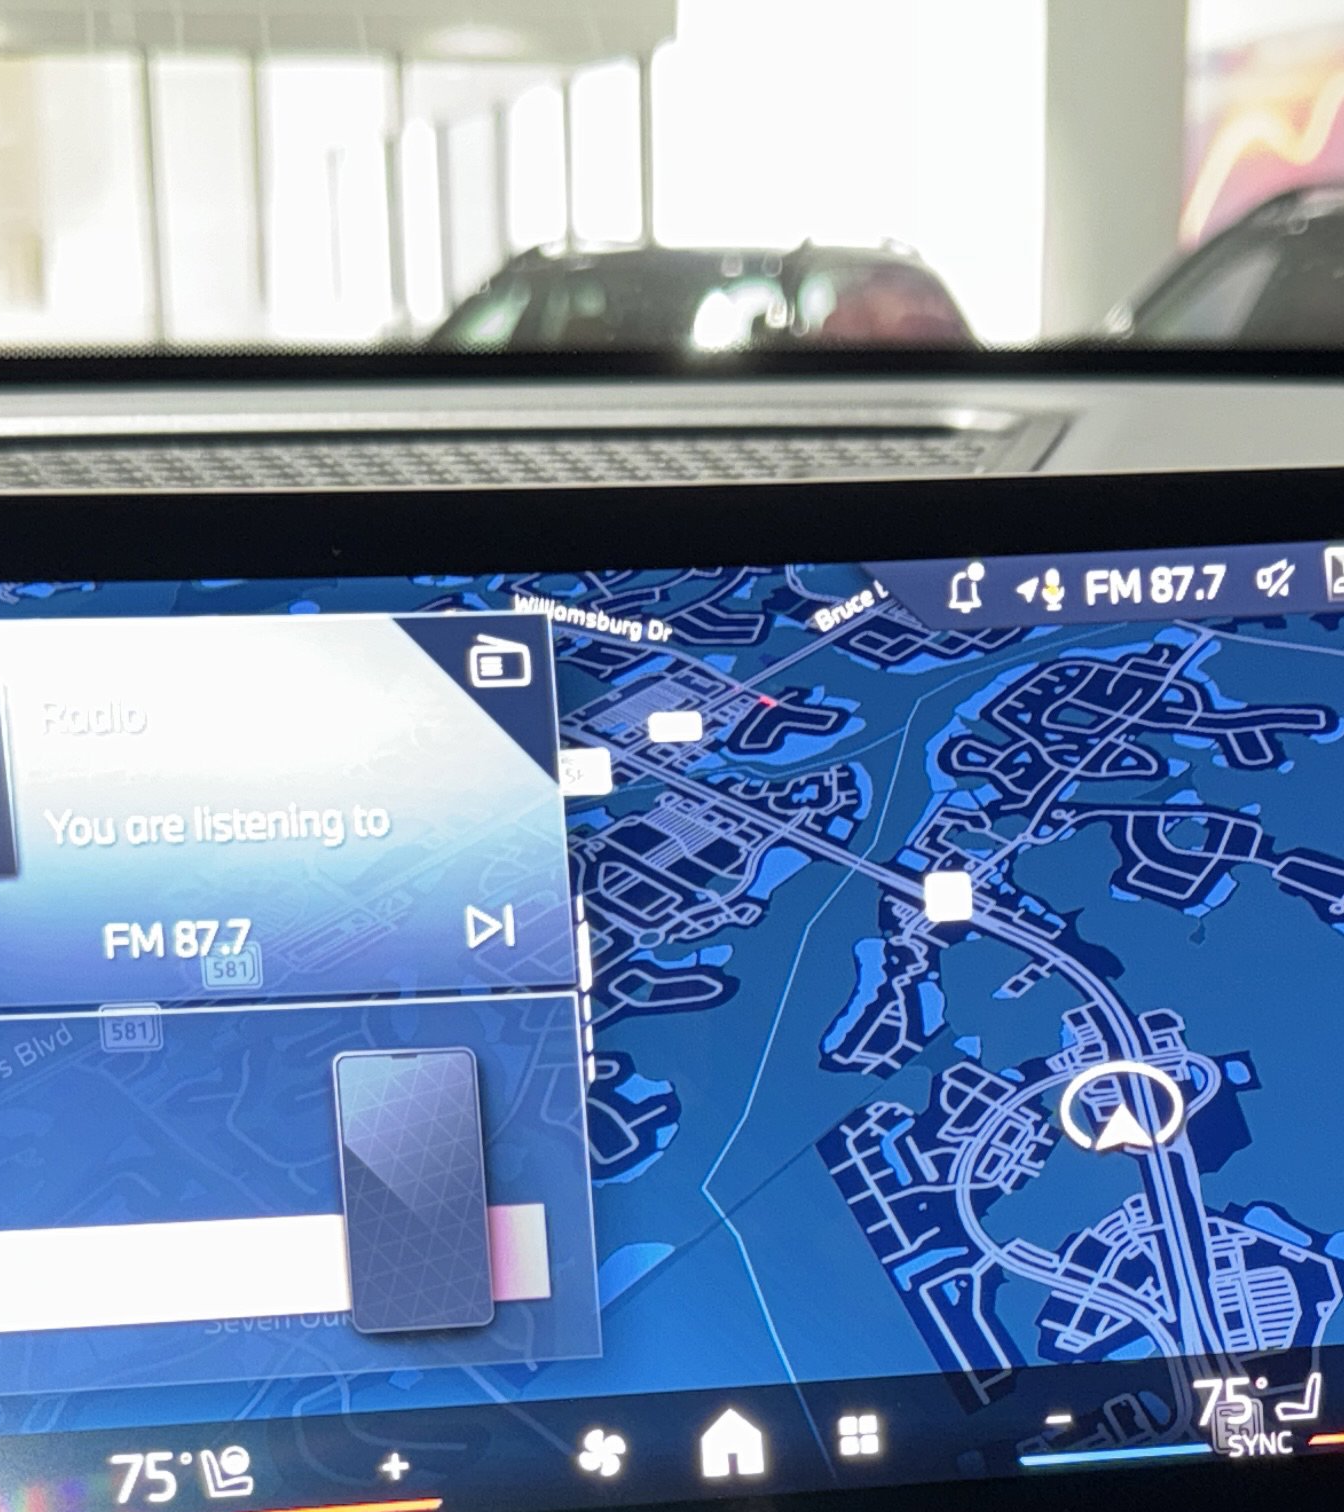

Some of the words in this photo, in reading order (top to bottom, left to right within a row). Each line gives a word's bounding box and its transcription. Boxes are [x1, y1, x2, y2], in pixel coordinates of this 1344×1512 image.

[1086, 567, 1142, 605] FM
[1150, 564, 1227, 603] 87.7
[513, 593, 643, 642] Williamsburg
[646, 619, 673, 642] Dr
[813, 588, 875, 633] Bruce
[43, 702, 149, 736] Radio
[45, 808, 116, 847] You
[125, 814, 185, 845] are
[193, 802, 346, 847] listening
[353, 803, 391, 838] to
[104, 921, 165, 960] FM
[174, 917, 252, 958] 87.7
[213, 962, 248, 980] 581
[13, 1022, 74, 1068] Blvd
[112, 1021, 148, 1042] 581
[1227, 1430, 1294, 1457] SYNC
